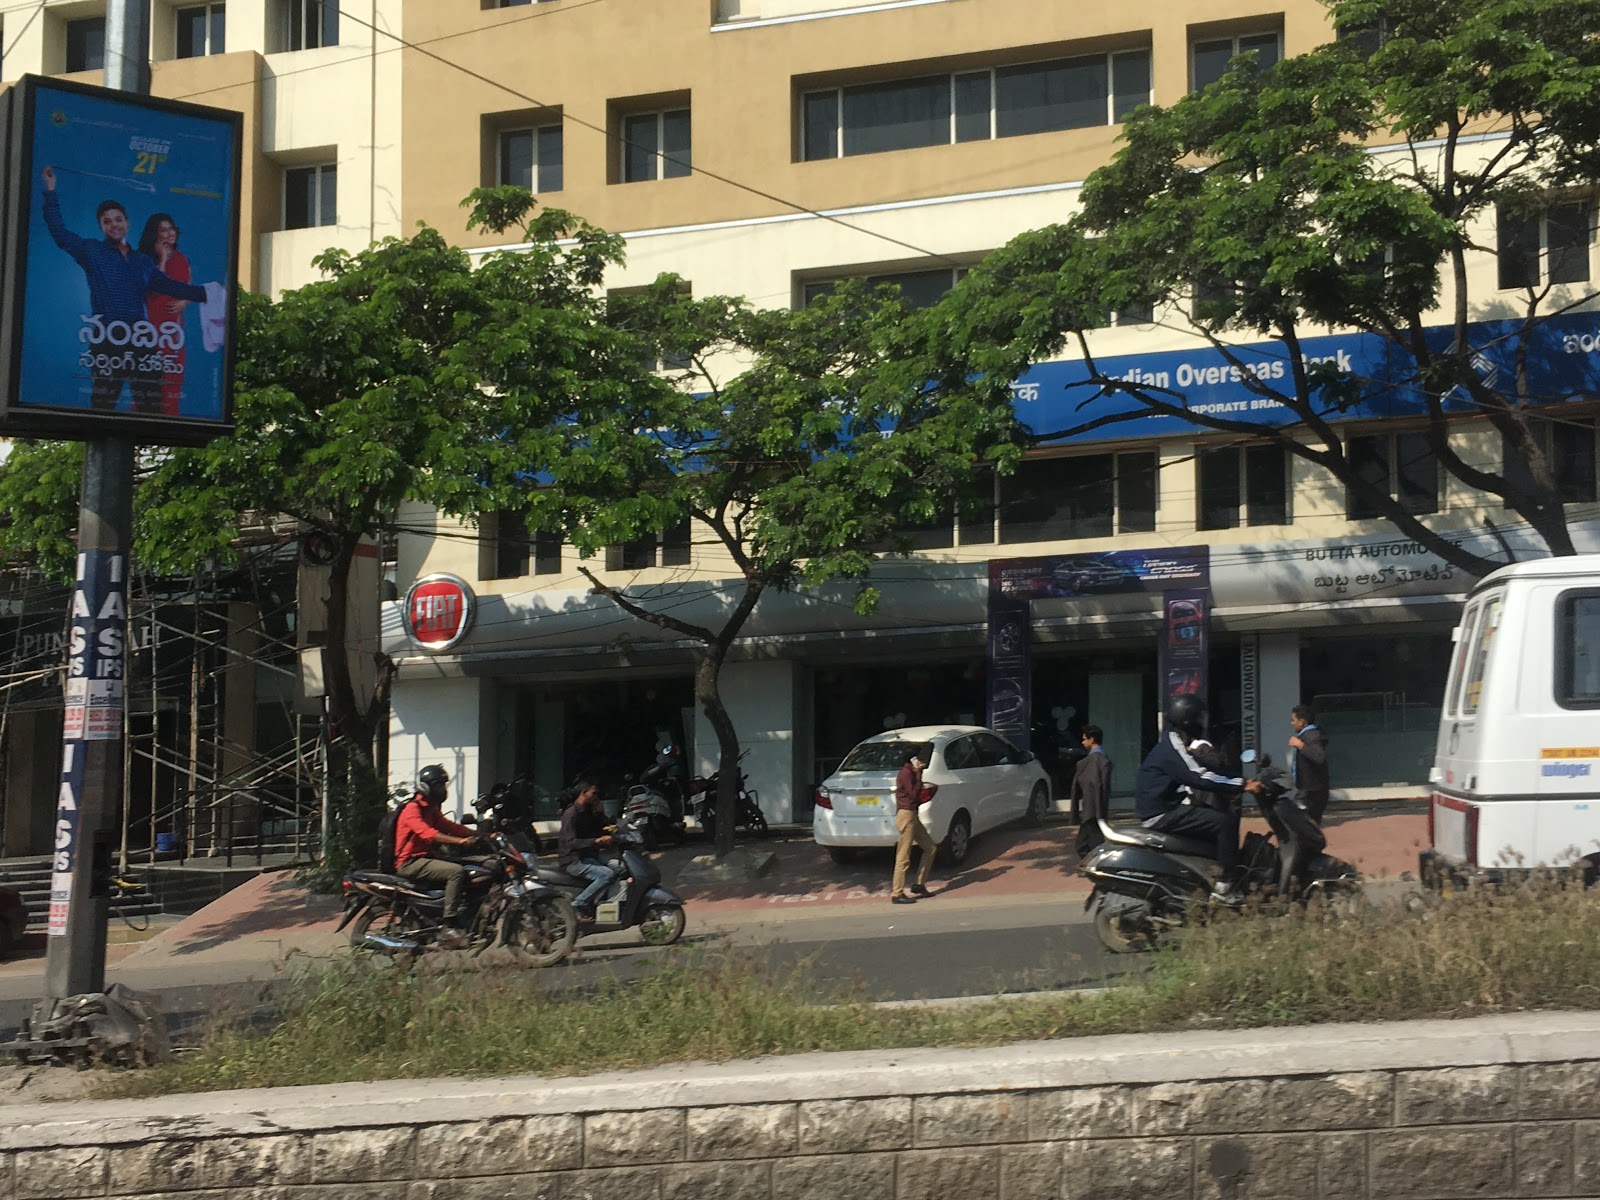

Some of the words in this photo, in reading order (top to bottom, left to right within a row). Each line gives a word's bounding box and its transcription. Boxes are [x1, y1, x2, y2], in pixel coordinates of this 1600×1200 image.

[79, 314, 185, 350] నందిని
[79, 350, 136, 376] నర్సింగ్
[138, 352, 184, 374] హోమ్
[1306, 547, 1355, 561] BUTTA
[416, 594, 459, 631] FIAT
[1243, 641, 1255, 712] AUTOMOTIVE
